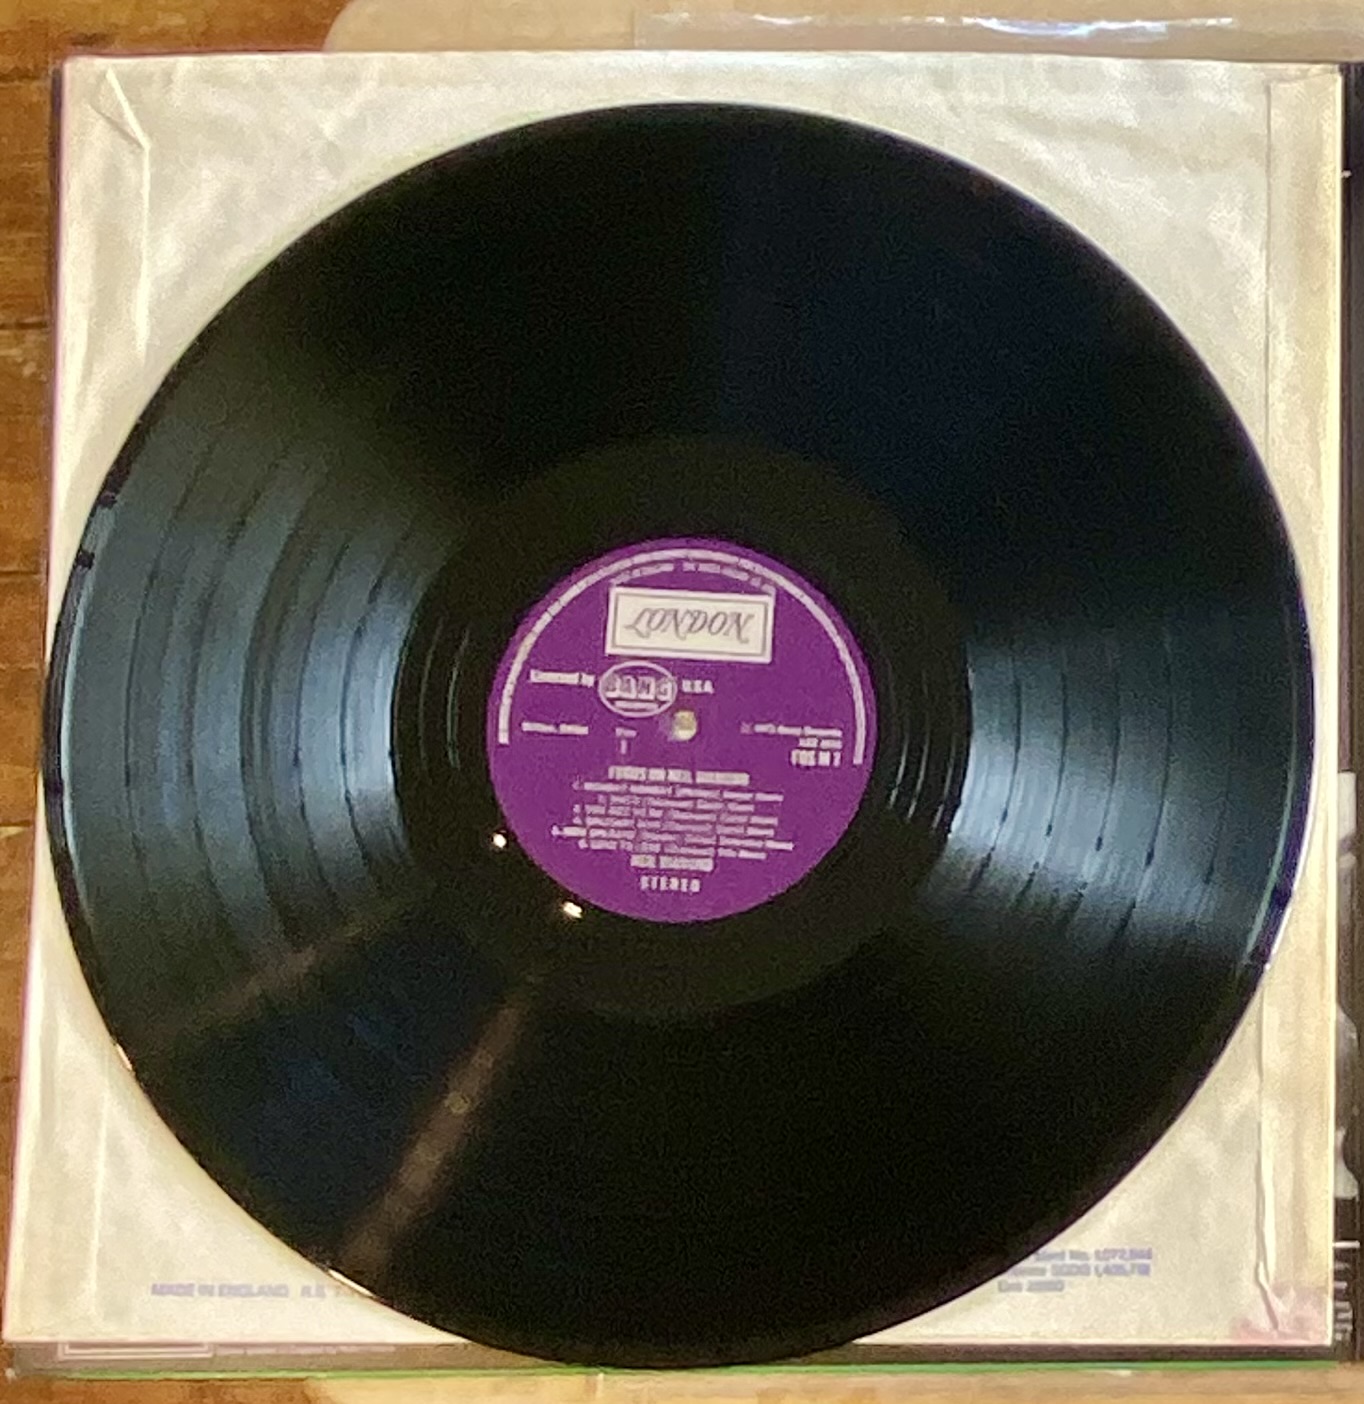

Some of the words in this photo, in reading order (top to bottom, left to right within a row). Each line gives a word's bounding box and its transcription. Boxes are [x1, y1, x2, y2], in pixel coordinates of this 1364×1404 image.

[625, 607, 756, 644] LONDON
[604, 673, 673, 700] BANG
[640, 875, 701, 892] STEREO
